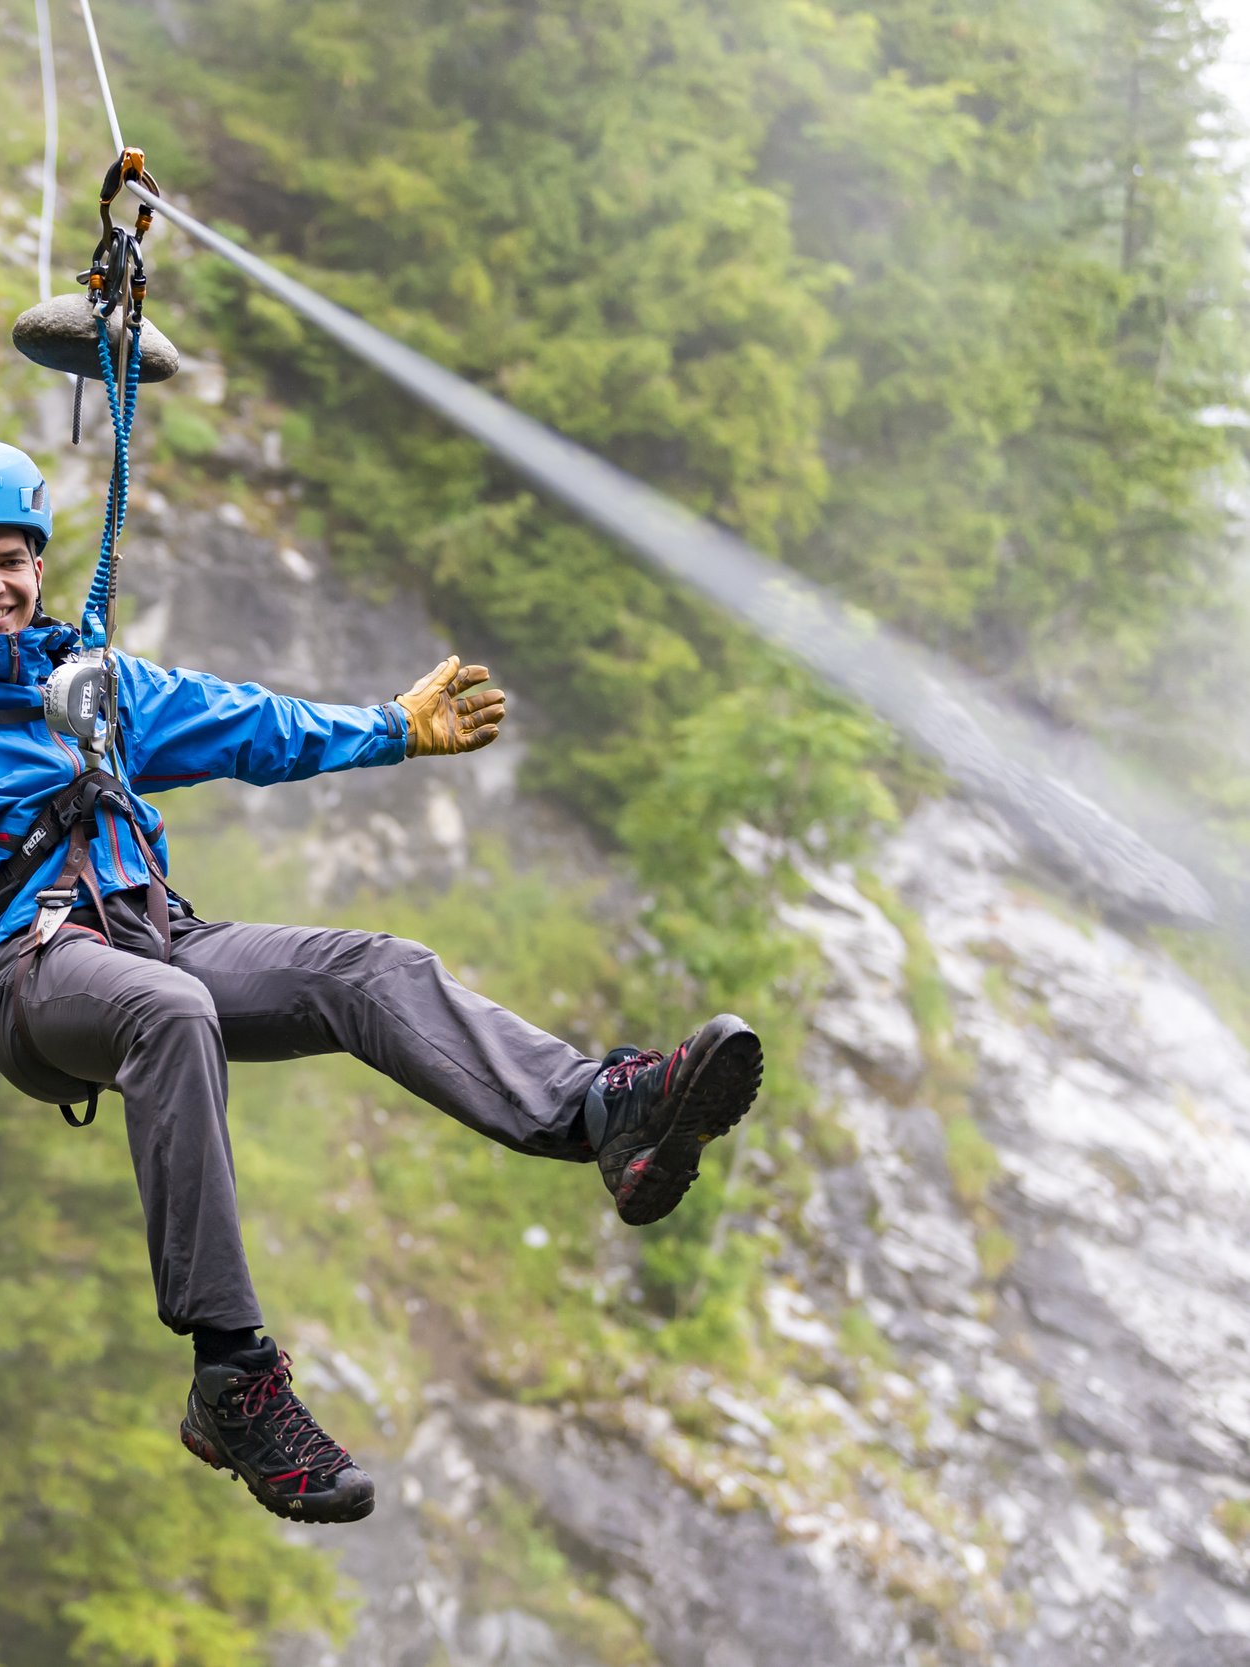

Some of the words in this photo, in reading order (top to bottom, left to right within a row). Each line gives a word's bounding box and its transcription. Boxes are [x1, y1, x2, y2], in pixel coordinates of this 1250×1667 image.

[51, 678, 63, 718] SCORPIO
[80, 680, 94, 719] PETZL
[22, 826, 47, 857] PETZL
